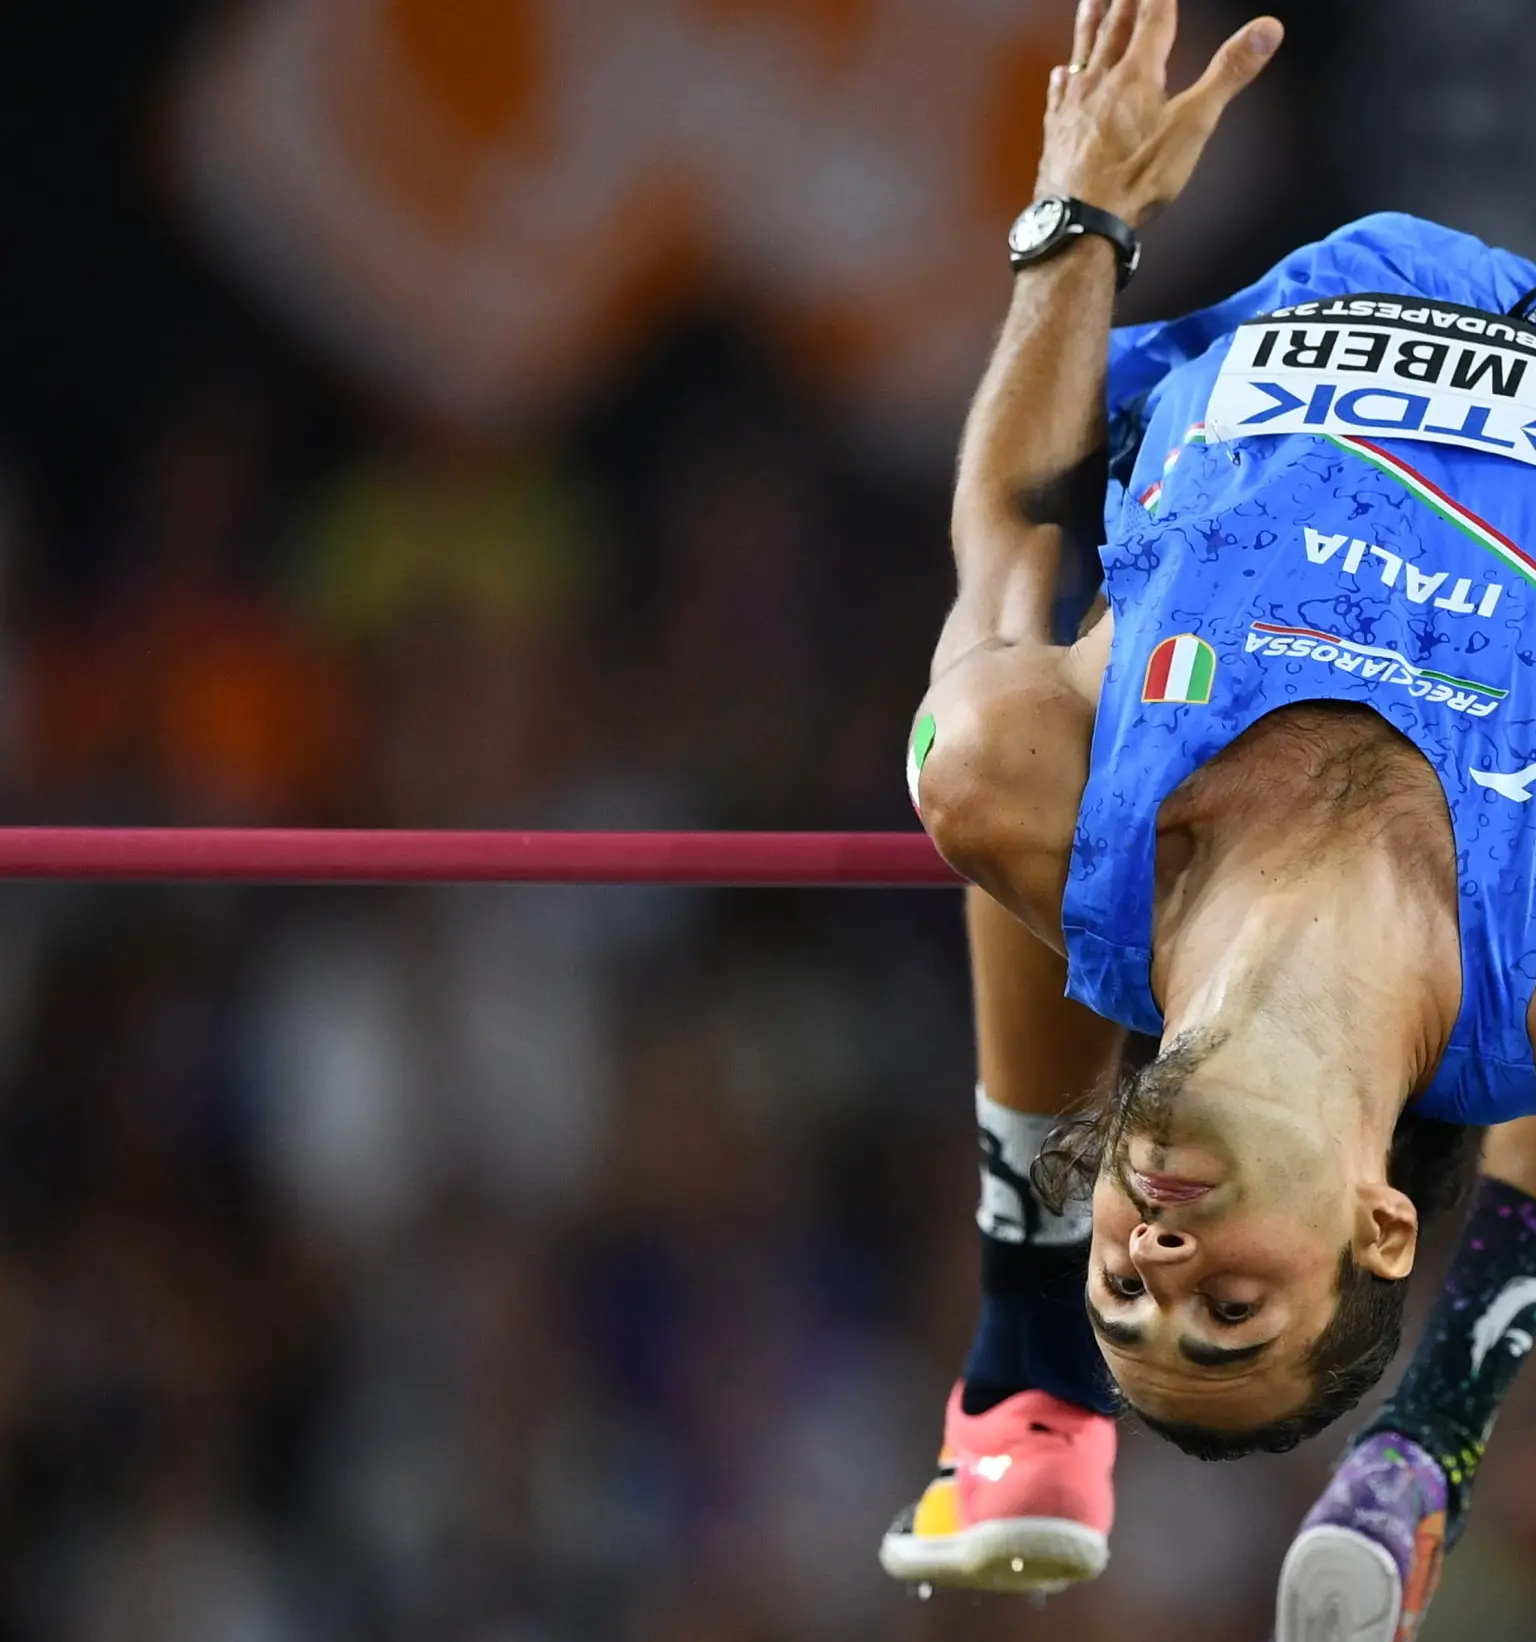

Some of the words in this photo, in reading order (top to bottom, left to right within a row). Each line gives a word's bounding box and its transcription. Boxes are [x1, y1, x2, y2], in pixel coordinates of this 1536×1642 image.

[1239, 381, 1515, 449] TDK
[1303, 526, 1503, 618] ITALIA
[1244, 632, 1498, 717] FRECCIAROSSA
